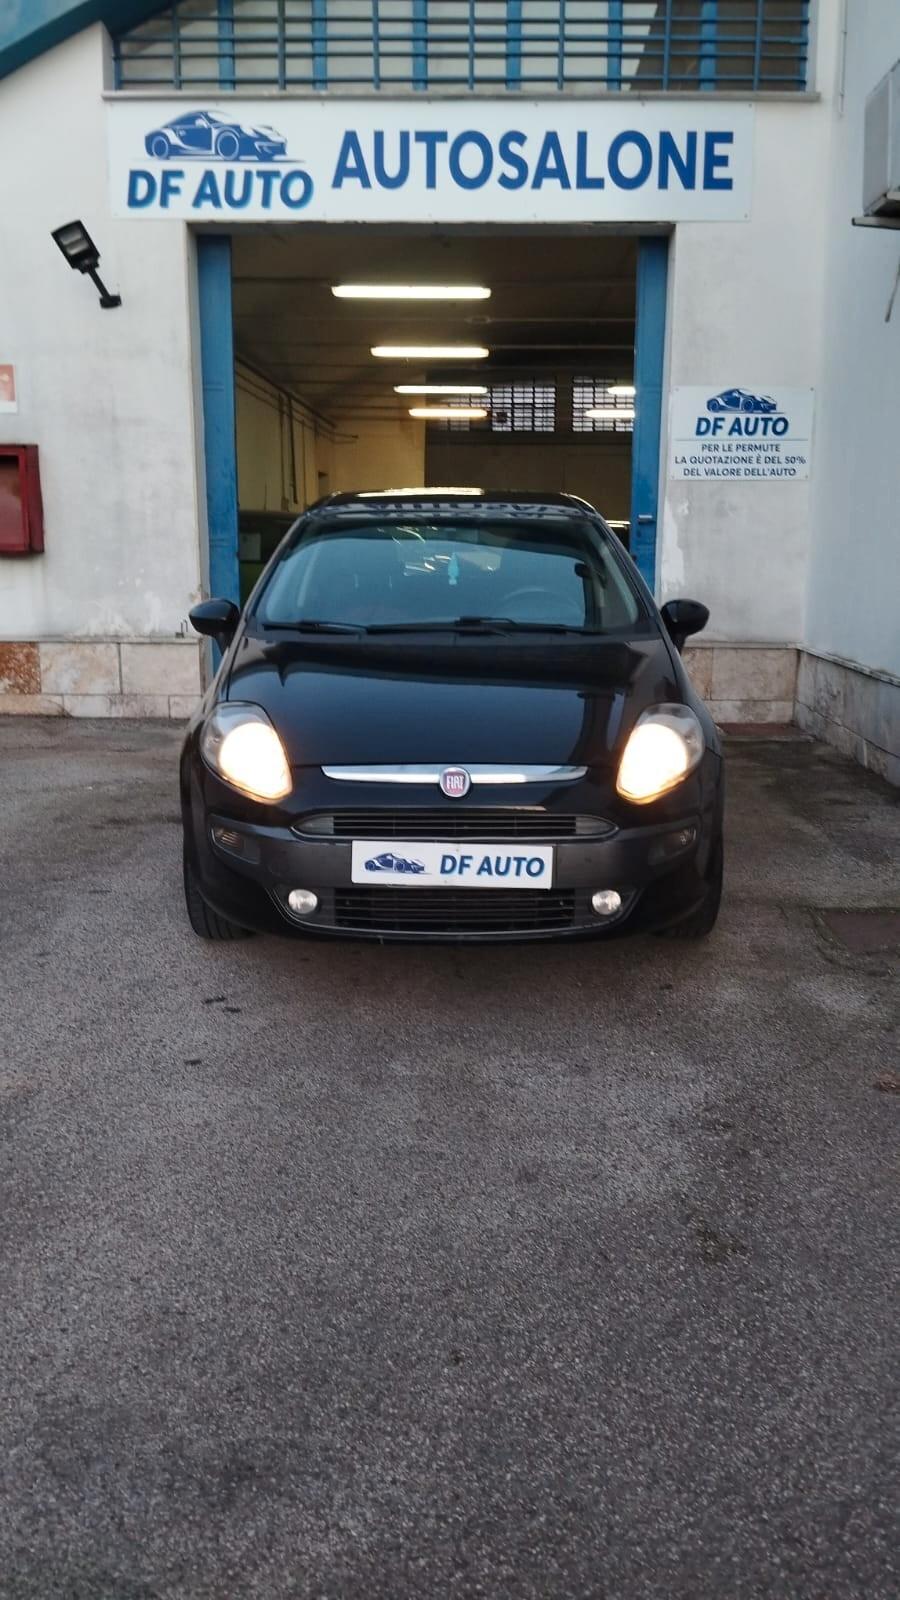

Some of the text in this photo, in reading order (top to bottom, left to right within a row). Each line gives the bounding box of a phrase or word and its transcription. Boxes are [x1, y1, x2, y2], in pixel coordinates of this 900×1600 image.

[331, 130, 734, 191] AUTOSALONE
[126, 169, 314, 210] DF AUTO
[695, 416, 790, 437] DF AUTO
[701, 443, 781, 452] PER LE PERMUTE
[674, 454, 806, 465] LA QUOTAZIONE È DEL 50%
[683, 468, 797, 477] DEL VALORE DELL'AUTO
[446, 775, 465, 790] FIAT
[439, 854, 546, 878] DF AUTO
